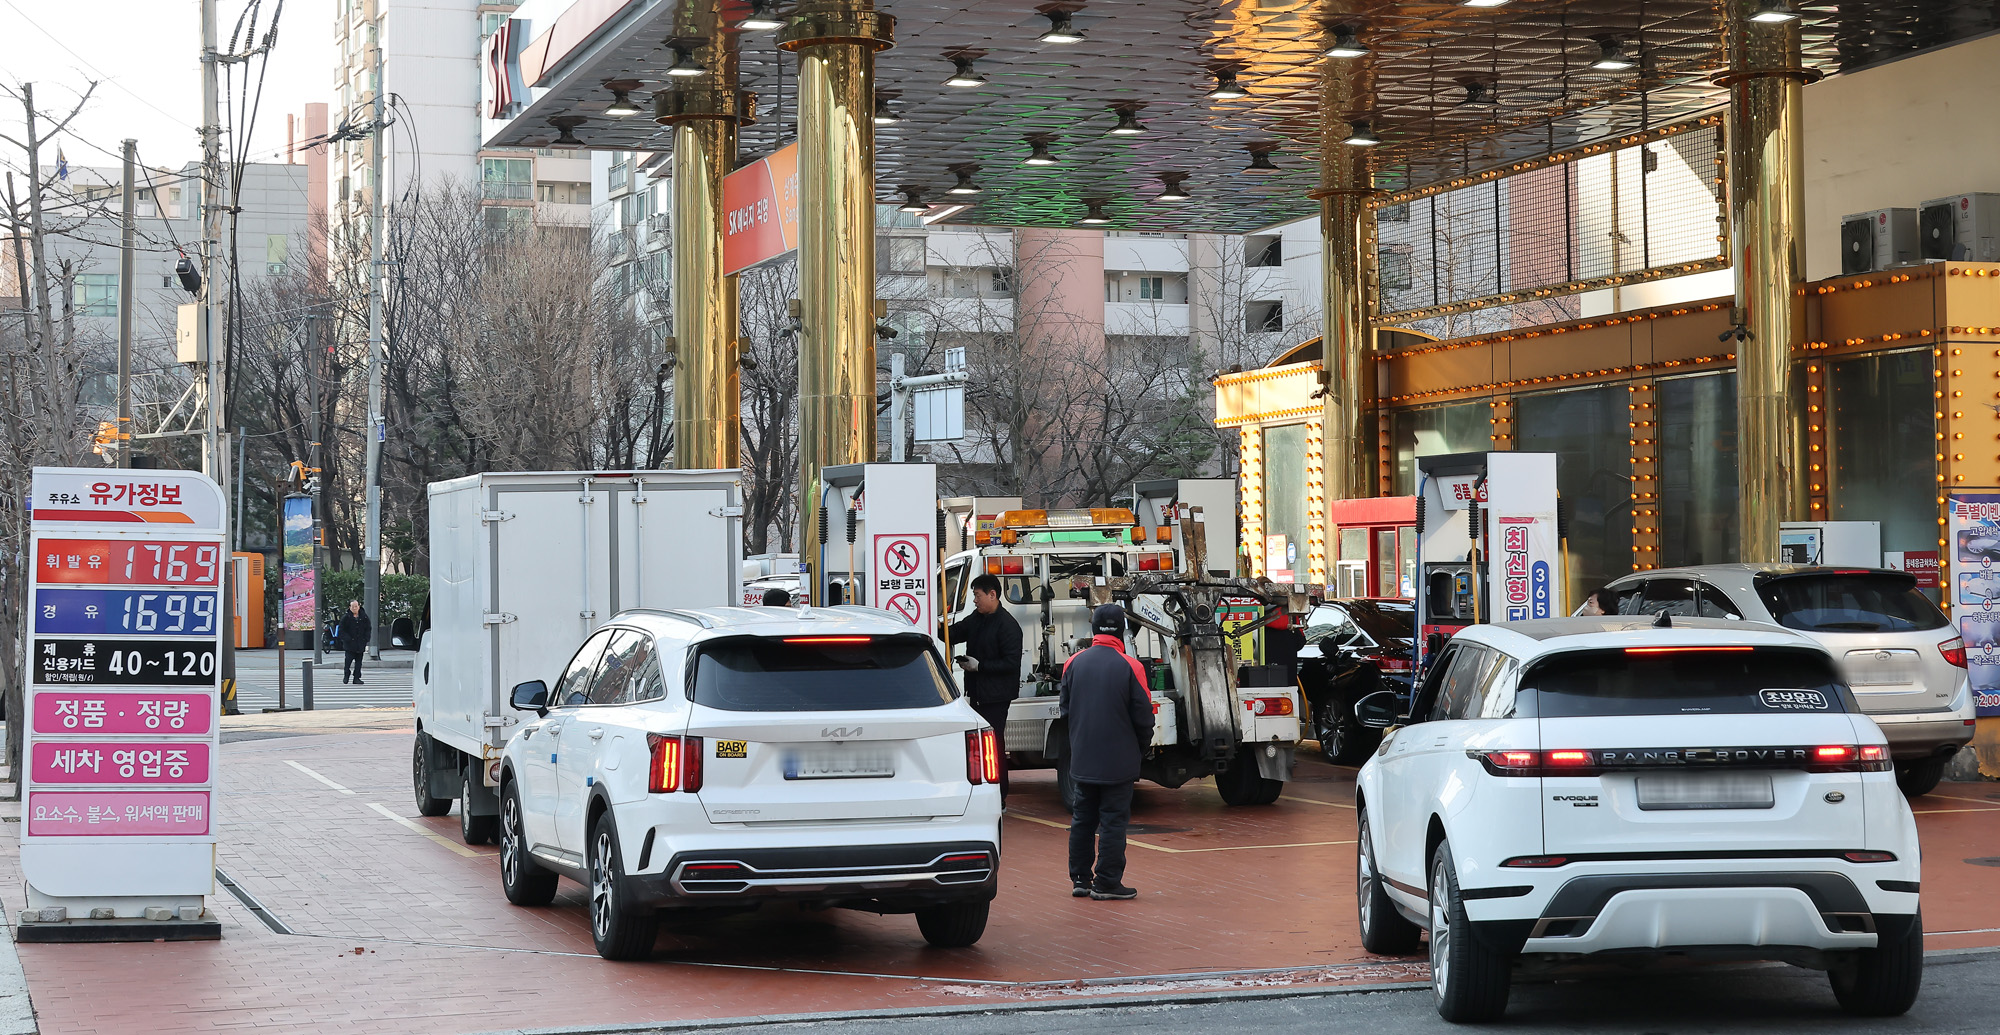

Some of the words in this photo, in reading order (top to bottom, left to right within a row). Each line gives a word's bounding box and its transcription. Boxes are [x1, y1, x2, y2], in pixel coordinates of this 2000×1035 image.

[488, 18, 512, 119] SK
[729, 202, 754, 236] SK에너지
[757, 196, 768, 225] 직영
[1961, 211, 1969, 219] LG
[1879, 226, 1886, 234] LG
[49, 493, 80, 504] 주유소
[89, 482, 182, 506] 유가정보
[1453, 483, 1472, 500] 정품
[1955, 503, 2000, 520] 특별이벤
[124, 544, 218, 582] 1769
[1505, 527, 1529, 604] 최신형
[1979, 569, 1993, 580] 버블
[880, 579, 901, 590] 보행
[904, 579, 925, 590] 금지
[1535, 567, 1546, 617] 365
[122, 594, 215, 632] 1699
[43, 657, 96, 671] 신용카드
[1766, 692, 1821, 705] 초보운전
[54, 700, 108, 728] 정품
[136, 700, 190, 729] 정량
[821, 726, 863, 738] KIA
[717, 741, 747, 752] BABY
[1603, 751, 1697, 760] RANGE
[1716, 750, 1806, 760] ROVER
[50, 749, 104, 774] 세차
[112, 750, 190, 778] 영업중
[33, 805, 83, 824] 요소수,
[86, 805, 121, 824] 불스,
[124, 805, 169, 823] 워셔액
[172, 805, 203, 823] 판매
